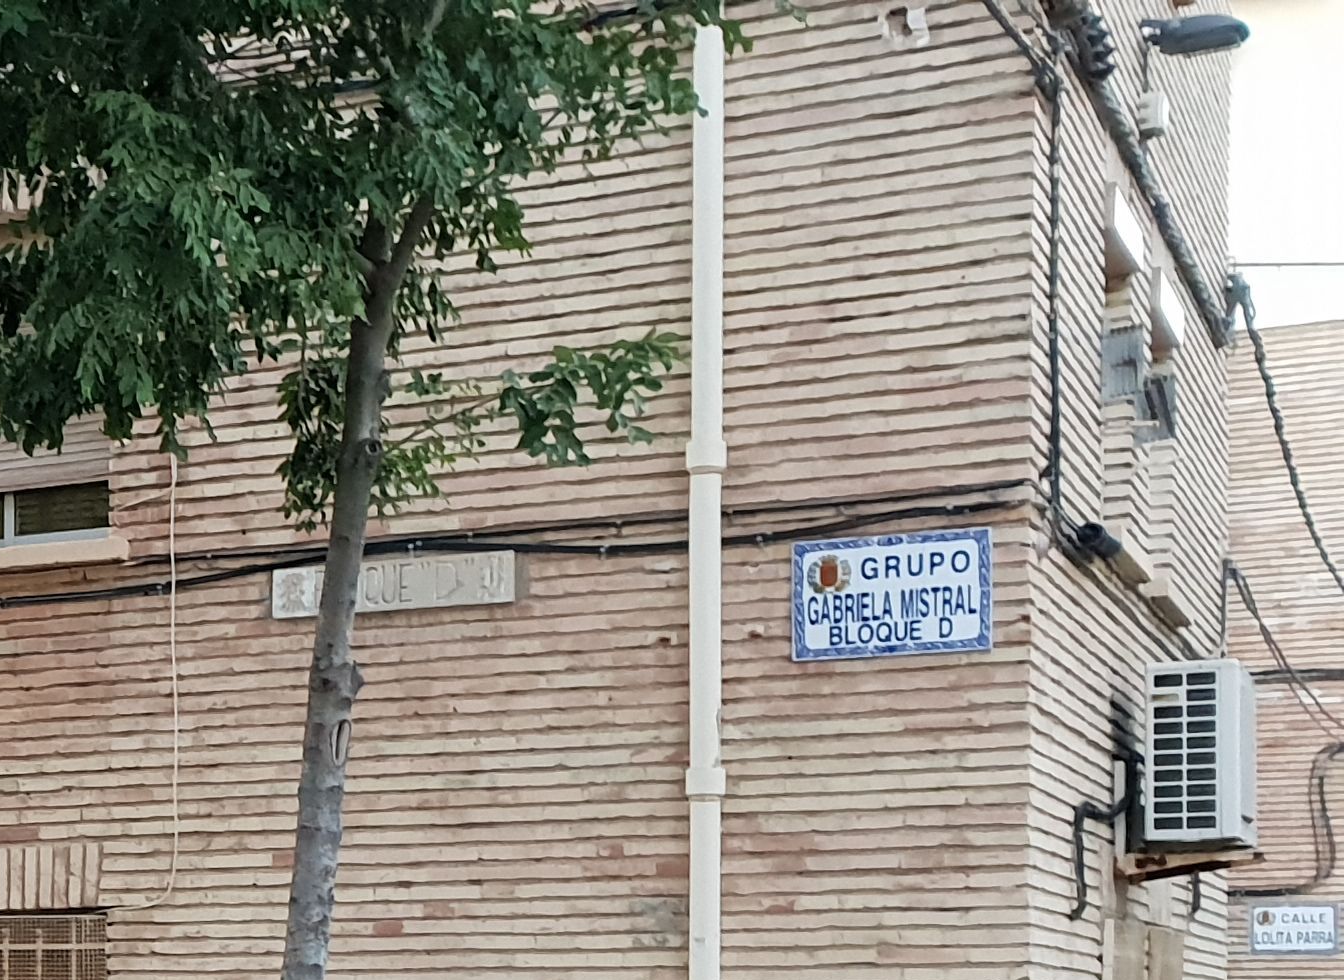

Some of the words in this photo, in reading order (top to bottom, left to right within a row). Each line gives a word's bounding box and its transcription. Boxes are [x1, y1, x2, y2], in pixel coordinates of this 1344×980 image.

[861, 550, 971, 580] GRUPO
[807, 590, 893, 626] GABRIELA
[900, 585, 978, 620] MISTRAL
[829, 619, 923, 646] BLOQUE
[939, 617, 954, 639] D
[1281, 912, 1326, 924] CALLE
[1254, 931, 1293, 945] LOLITA
[1296, 930, 1334, 945] PARRA
